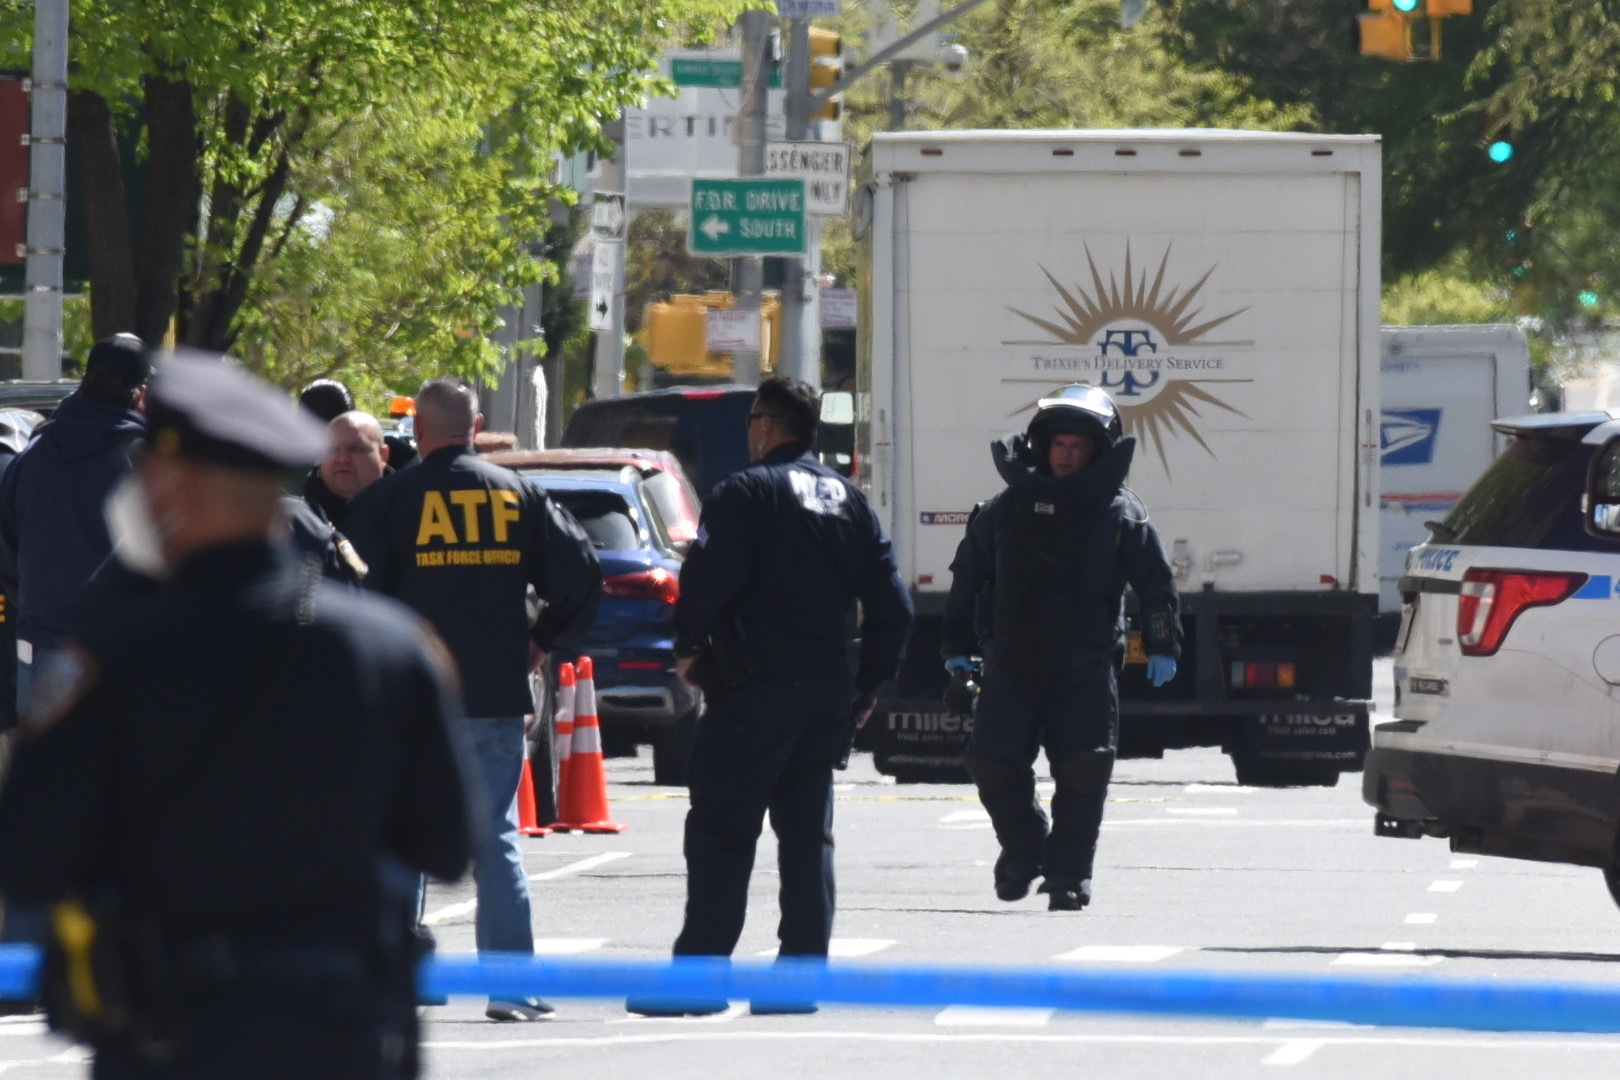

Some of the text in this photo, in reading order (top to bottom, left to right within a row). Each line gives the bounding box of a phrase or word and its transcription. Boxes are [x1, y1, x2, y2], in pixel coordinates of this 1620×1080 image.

[766, 150, 843, 173] SSENGER
[746, 188, 801, 211] DRIVE
[811, 180, 842, 204] NLY
[739, 217, 796, 239] SOUTH
[415, 488, 520, 545] ATF
[415, 550, 445, 567] TASK
[446, 549, 481, 565] FORCE
